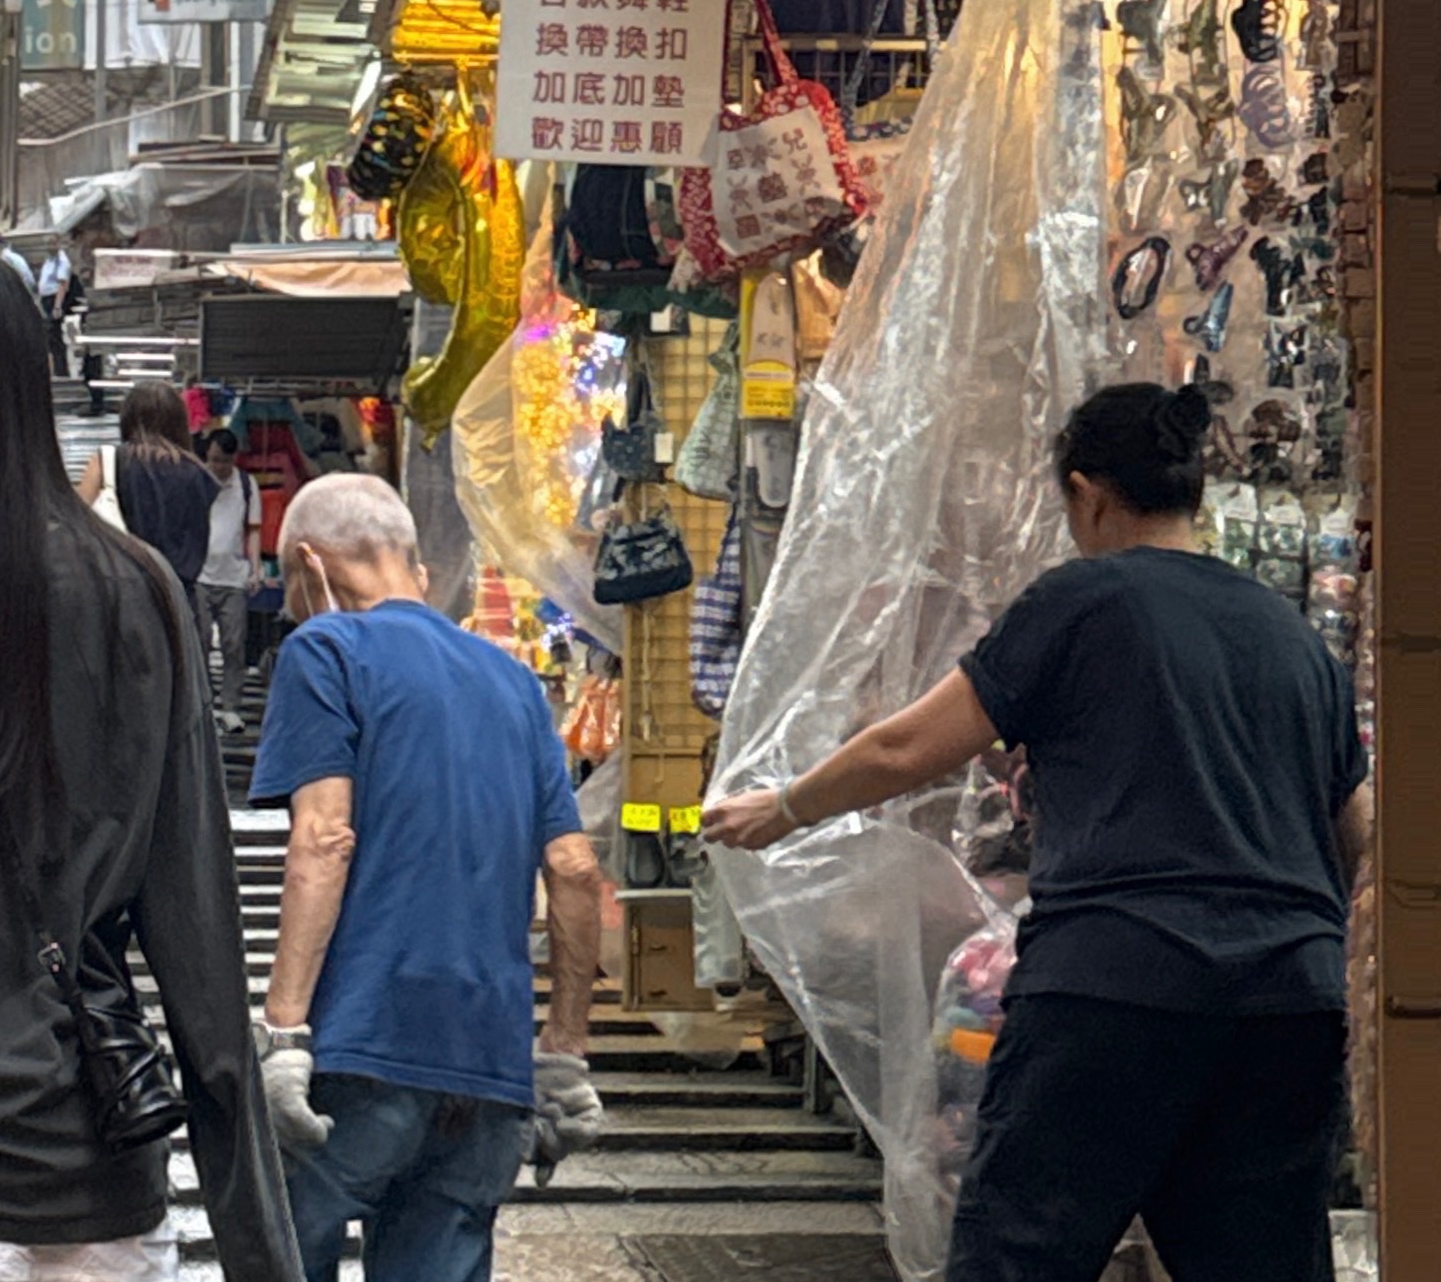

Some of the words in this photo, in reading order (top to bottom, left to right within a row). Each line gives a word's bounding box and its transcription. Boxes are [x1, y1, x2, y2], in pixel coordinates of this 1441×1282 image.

[23, 25, 78, 54] ion
[534, 22, 689, 60] 換帶換扣
[532, 70, 686, 109] 加底加墊
[531, 117, 684, 155] 歡迎惠顧
